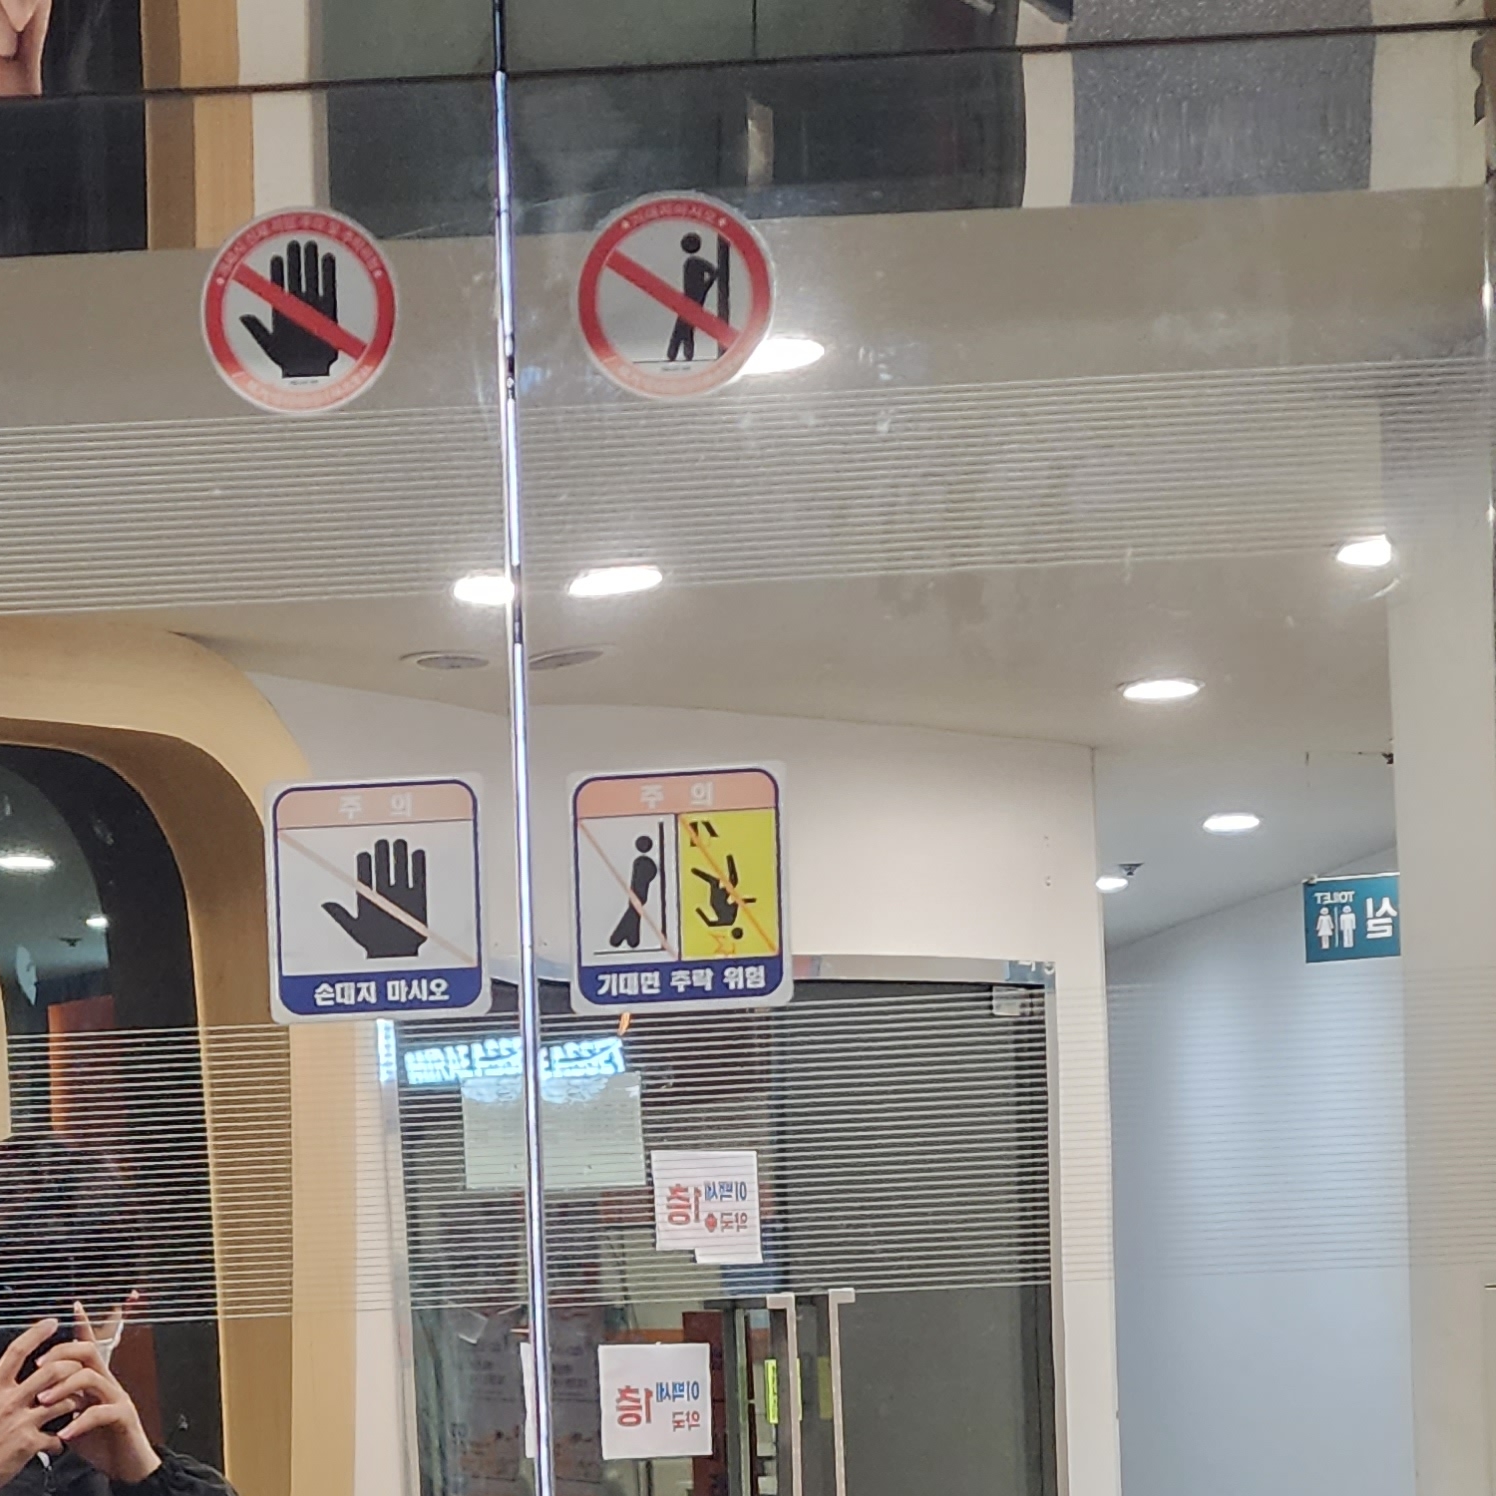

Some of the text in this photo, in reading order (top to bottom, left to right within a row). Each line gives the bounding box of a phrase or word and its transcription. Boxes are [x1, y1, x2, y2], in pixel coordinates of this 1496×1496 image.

[315, 978, 450, 1005] 손대지 마시오
[598, 965, 766, 996] 기대면 추락 위험
